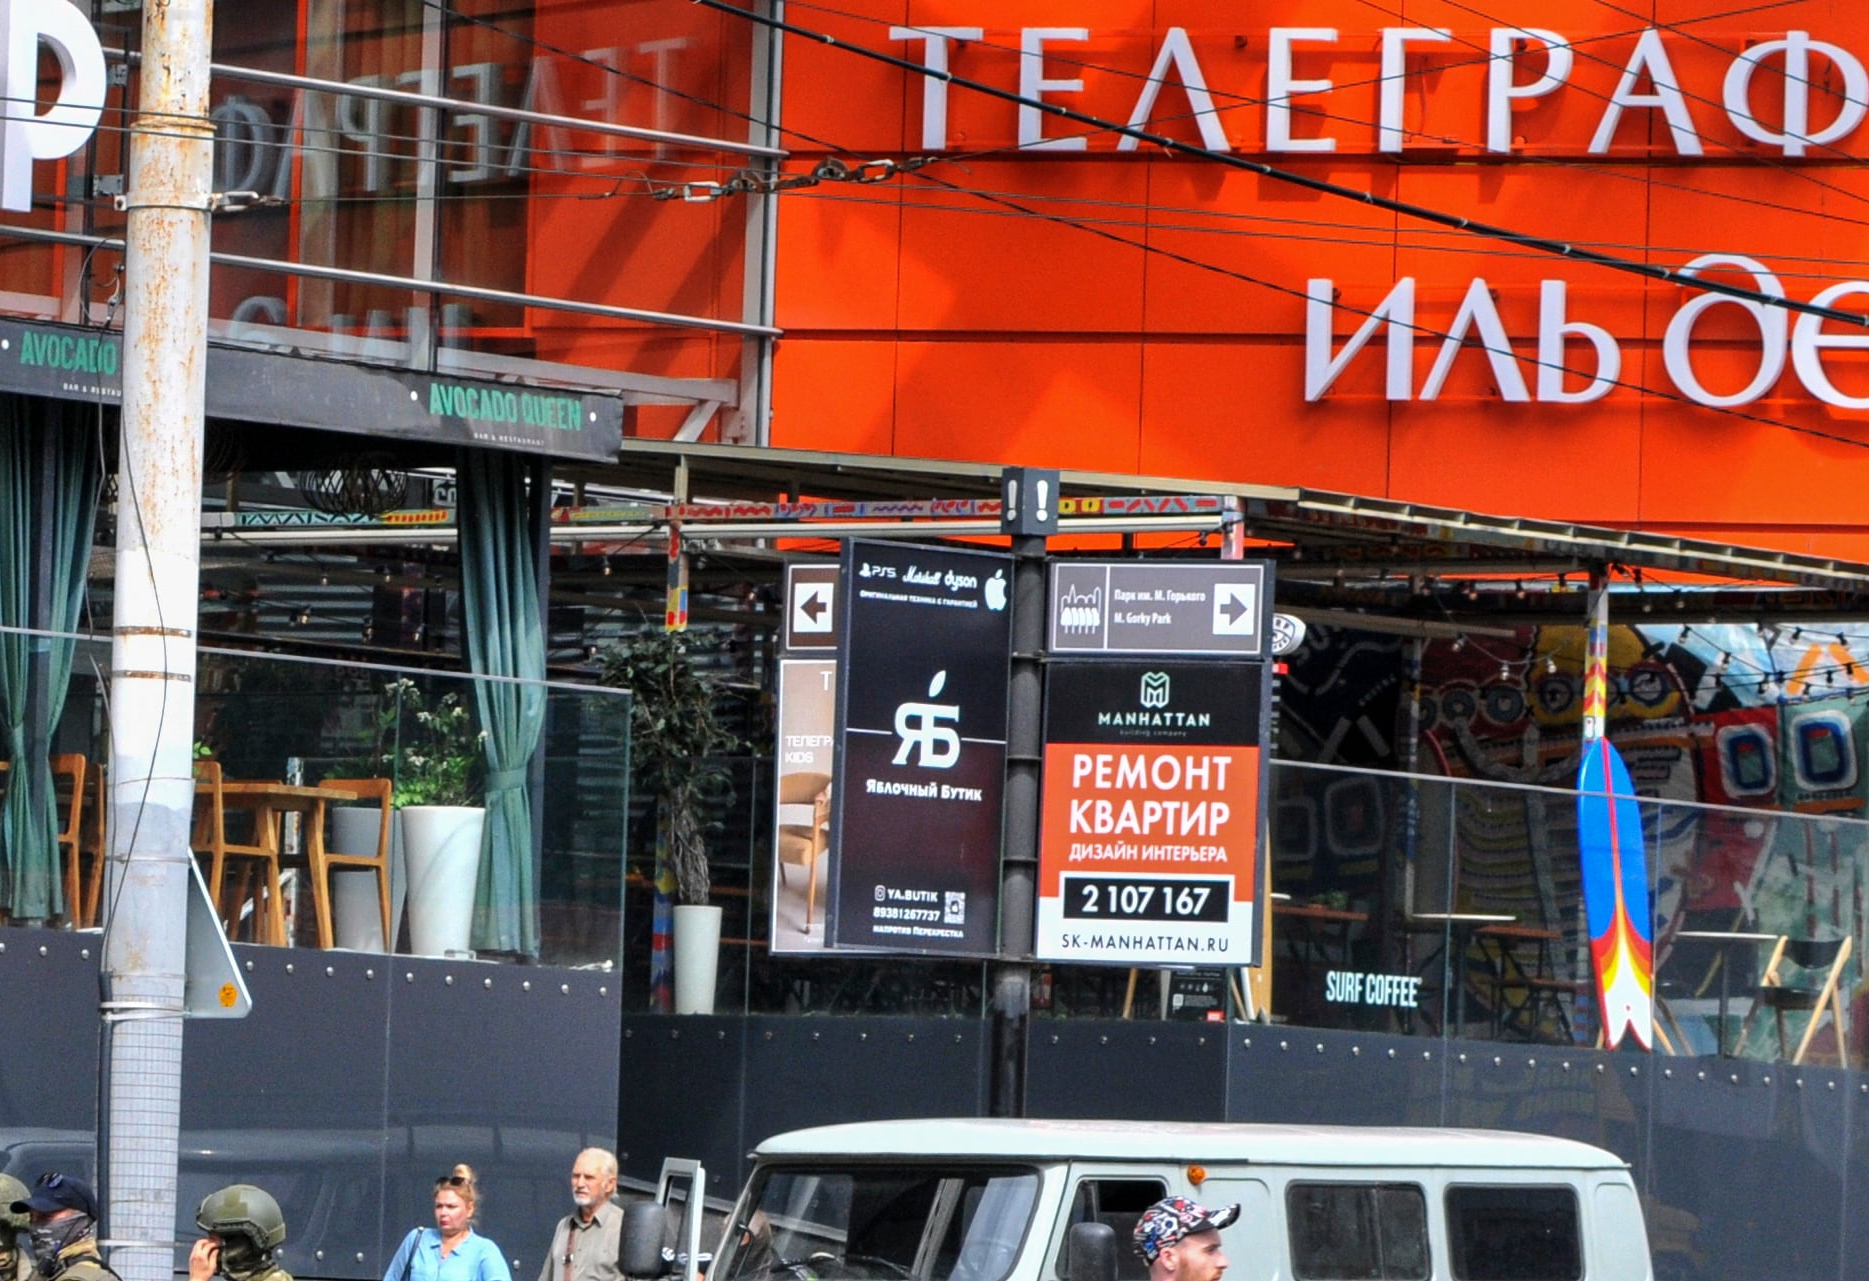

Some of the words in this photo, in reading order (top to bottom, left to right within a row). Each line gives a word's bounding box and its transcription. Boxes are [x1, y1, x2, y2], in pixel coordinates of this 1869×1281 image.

[889, 26, 1869, 157] ТЕЛЕГРАФ
[20, 331, 117, 376] AVOCADO
[429, 382, 518, 424] AVOCADO
[520, 392, 581, 432] QUEEN
[872, 565, 897, 579] PS5
[944, 568, 978, 592] dyson
[1114, 588, 1135, 603] Парк
[1167, 589, 1206, 604] Горького
[1126, 611, 1150, 627] Gorky
[1152, 611, 1172, 624] Park
[1097, 711, 1211, 727] MANHATTAN
[1072, 754, 1232, 791] РЕМОНТ
[1069, 799, 1230, 837] КВАРТИР
[1068, 840, 1138, 862] ДИЗАЙН
[1141, 845, 1228, 862] ИНТЕРЬЕРА
[886, 887, 939, 903] YA.BUTIK
[1082, 884, 1099, 912] 2
[1107, 885, 1155, 914] 107
[1162, 887, 1211, 915] 167
[1062, 933, 1229, 952] SK-MANHATTAN.RU
[1325, 969, 1364, 1003] SURF
[1365, 973, 1420, 1008] COFFEE
